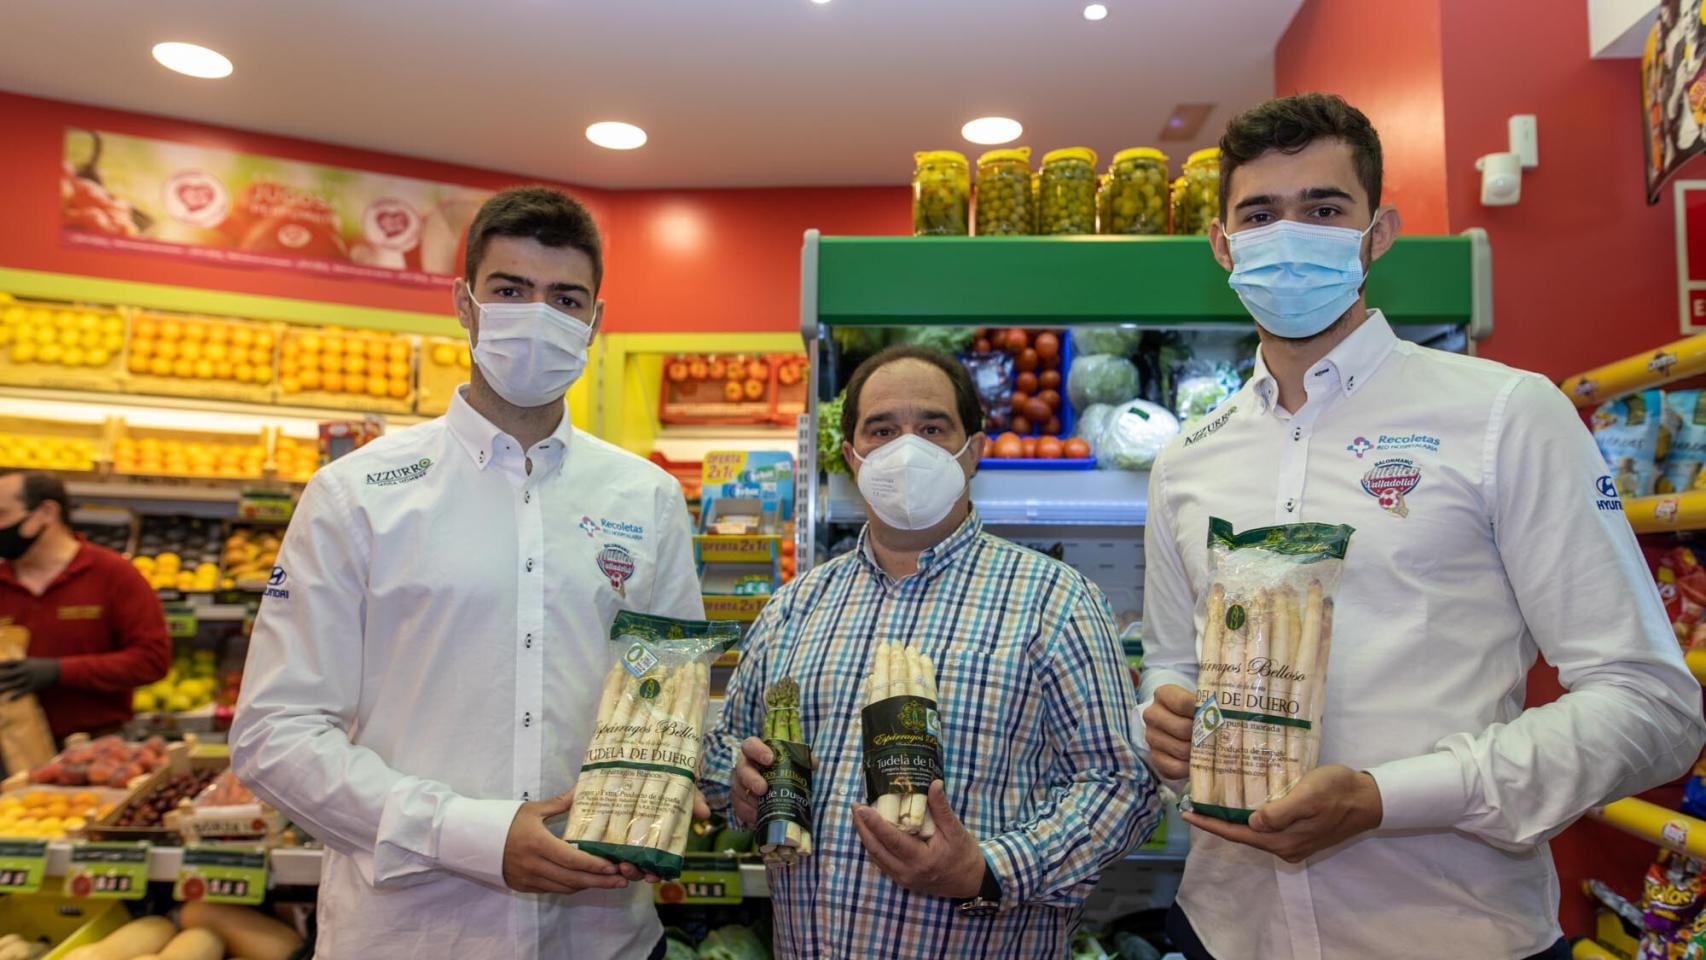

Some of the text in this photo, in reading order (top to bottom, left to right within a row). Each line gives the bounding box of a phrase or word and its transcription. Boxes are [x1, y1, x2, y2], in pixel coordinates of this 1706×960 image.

[1378, 434, 1440, 446] Recoletas
[706, 453, 742, 465] OFERTA
[1364, 478, 1415, 489] Valladolid
[1596, 500, 1623, 511] HYUN
[601, 519, 643, 534] Recoletas
[1246, 656, 1306, 682] Belloso
[1221, 691, 1242, 706] DE
[1246, 694, 1299, 714] DUERO
[629, 747, 648, 760] DE
[651, 749, 697, 768] DUERO
[877, 754, 910, 768] Tudela
[913, 755, 927, 766] de
[780, 787, 808, 807] Duero
